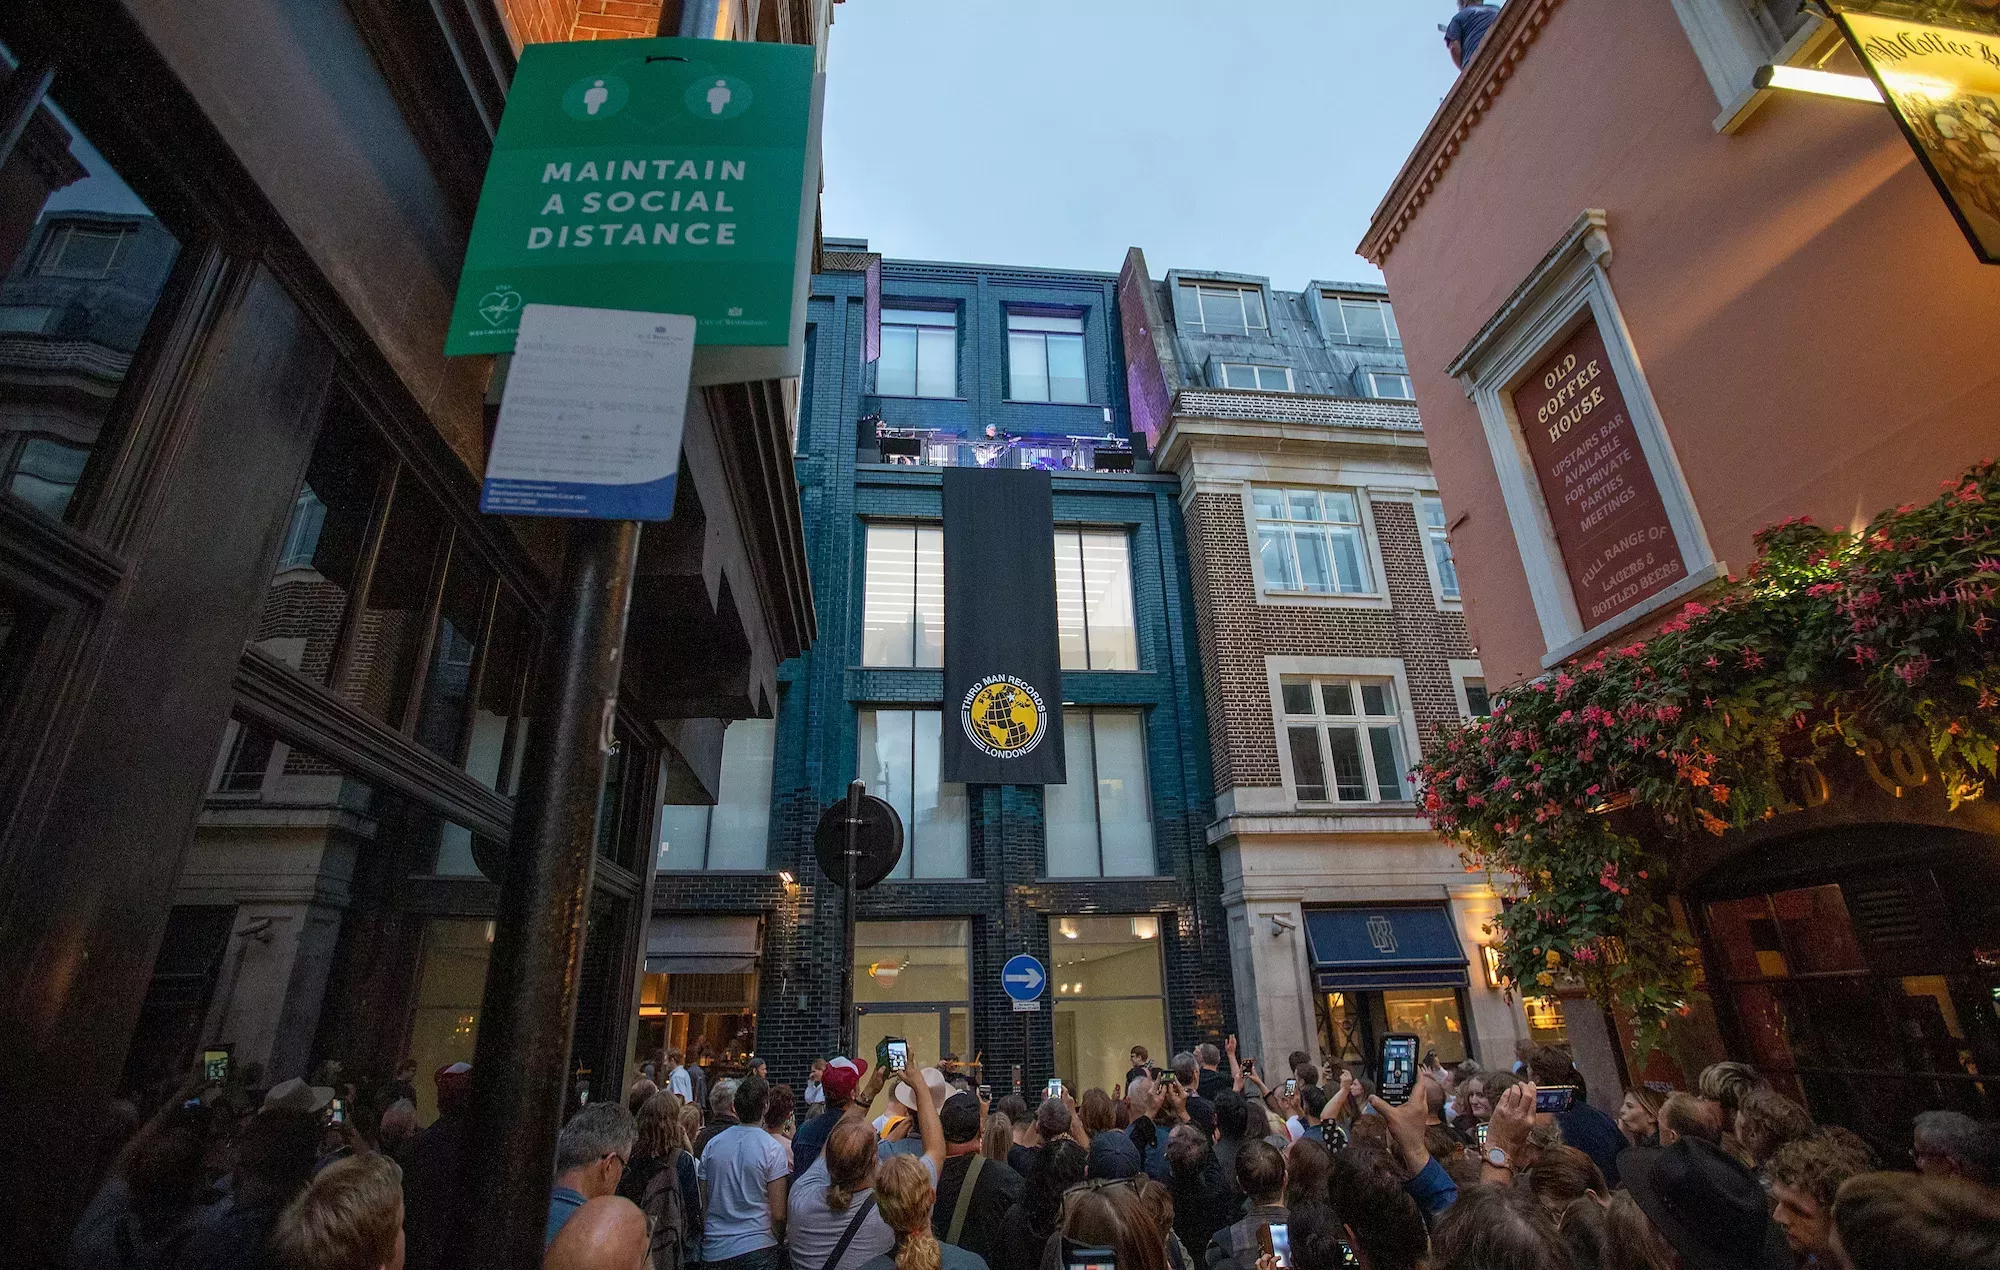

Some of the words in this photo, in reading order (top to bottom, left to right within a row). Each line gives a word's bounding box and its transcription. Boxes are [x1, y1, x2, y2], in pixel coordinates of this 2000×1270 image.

[1865, 33, 1908, 63] Old
[1897, 31, 1975, 58] Coffee
[541, 160, 746, 183] MAINTAIN
[541, 193, 564, 215] A
[581, 191, 734, 213] SOCIAL
[527, 223, 737, 249] DISTANCE
[1538, 359, 1601, 423] COFFEE
[1545, 353, 1577, 389] OLD
[1548, 386, 1605, 444] HOUSE
[1552, 433, 1599, 477] UPSTAIRS
[1600, 413, 1625, 439] BAR
[1564, 435, 1621, 487] AVAILABLE
[1565, 484, 1586, 506] FOR
[1586, 448, 1632, 489] PRIVATE
[1580, 474, 1624, 513] PARTIES
[1580, 486, 1636, 532] MEETINGS
[1582, 558, 1605, 588] FULL
[1604, 530, 1645, 562] RANGE
[1648, 526, 1667, 540] OF
[1601, 558, 1645, 592] LAGERS
[1646, 552, 1655, 565] &
[1591, 583, 1639, 618] BOTTLED
[1639, 558, 1679, 589] BEERS
[961, 682, 983, 710] THIRD
[982, 674, 1006, 686] MAN
[1008, 675, 1046, 713] RECORDS
[985, 746, 1027, 759] LONDON
